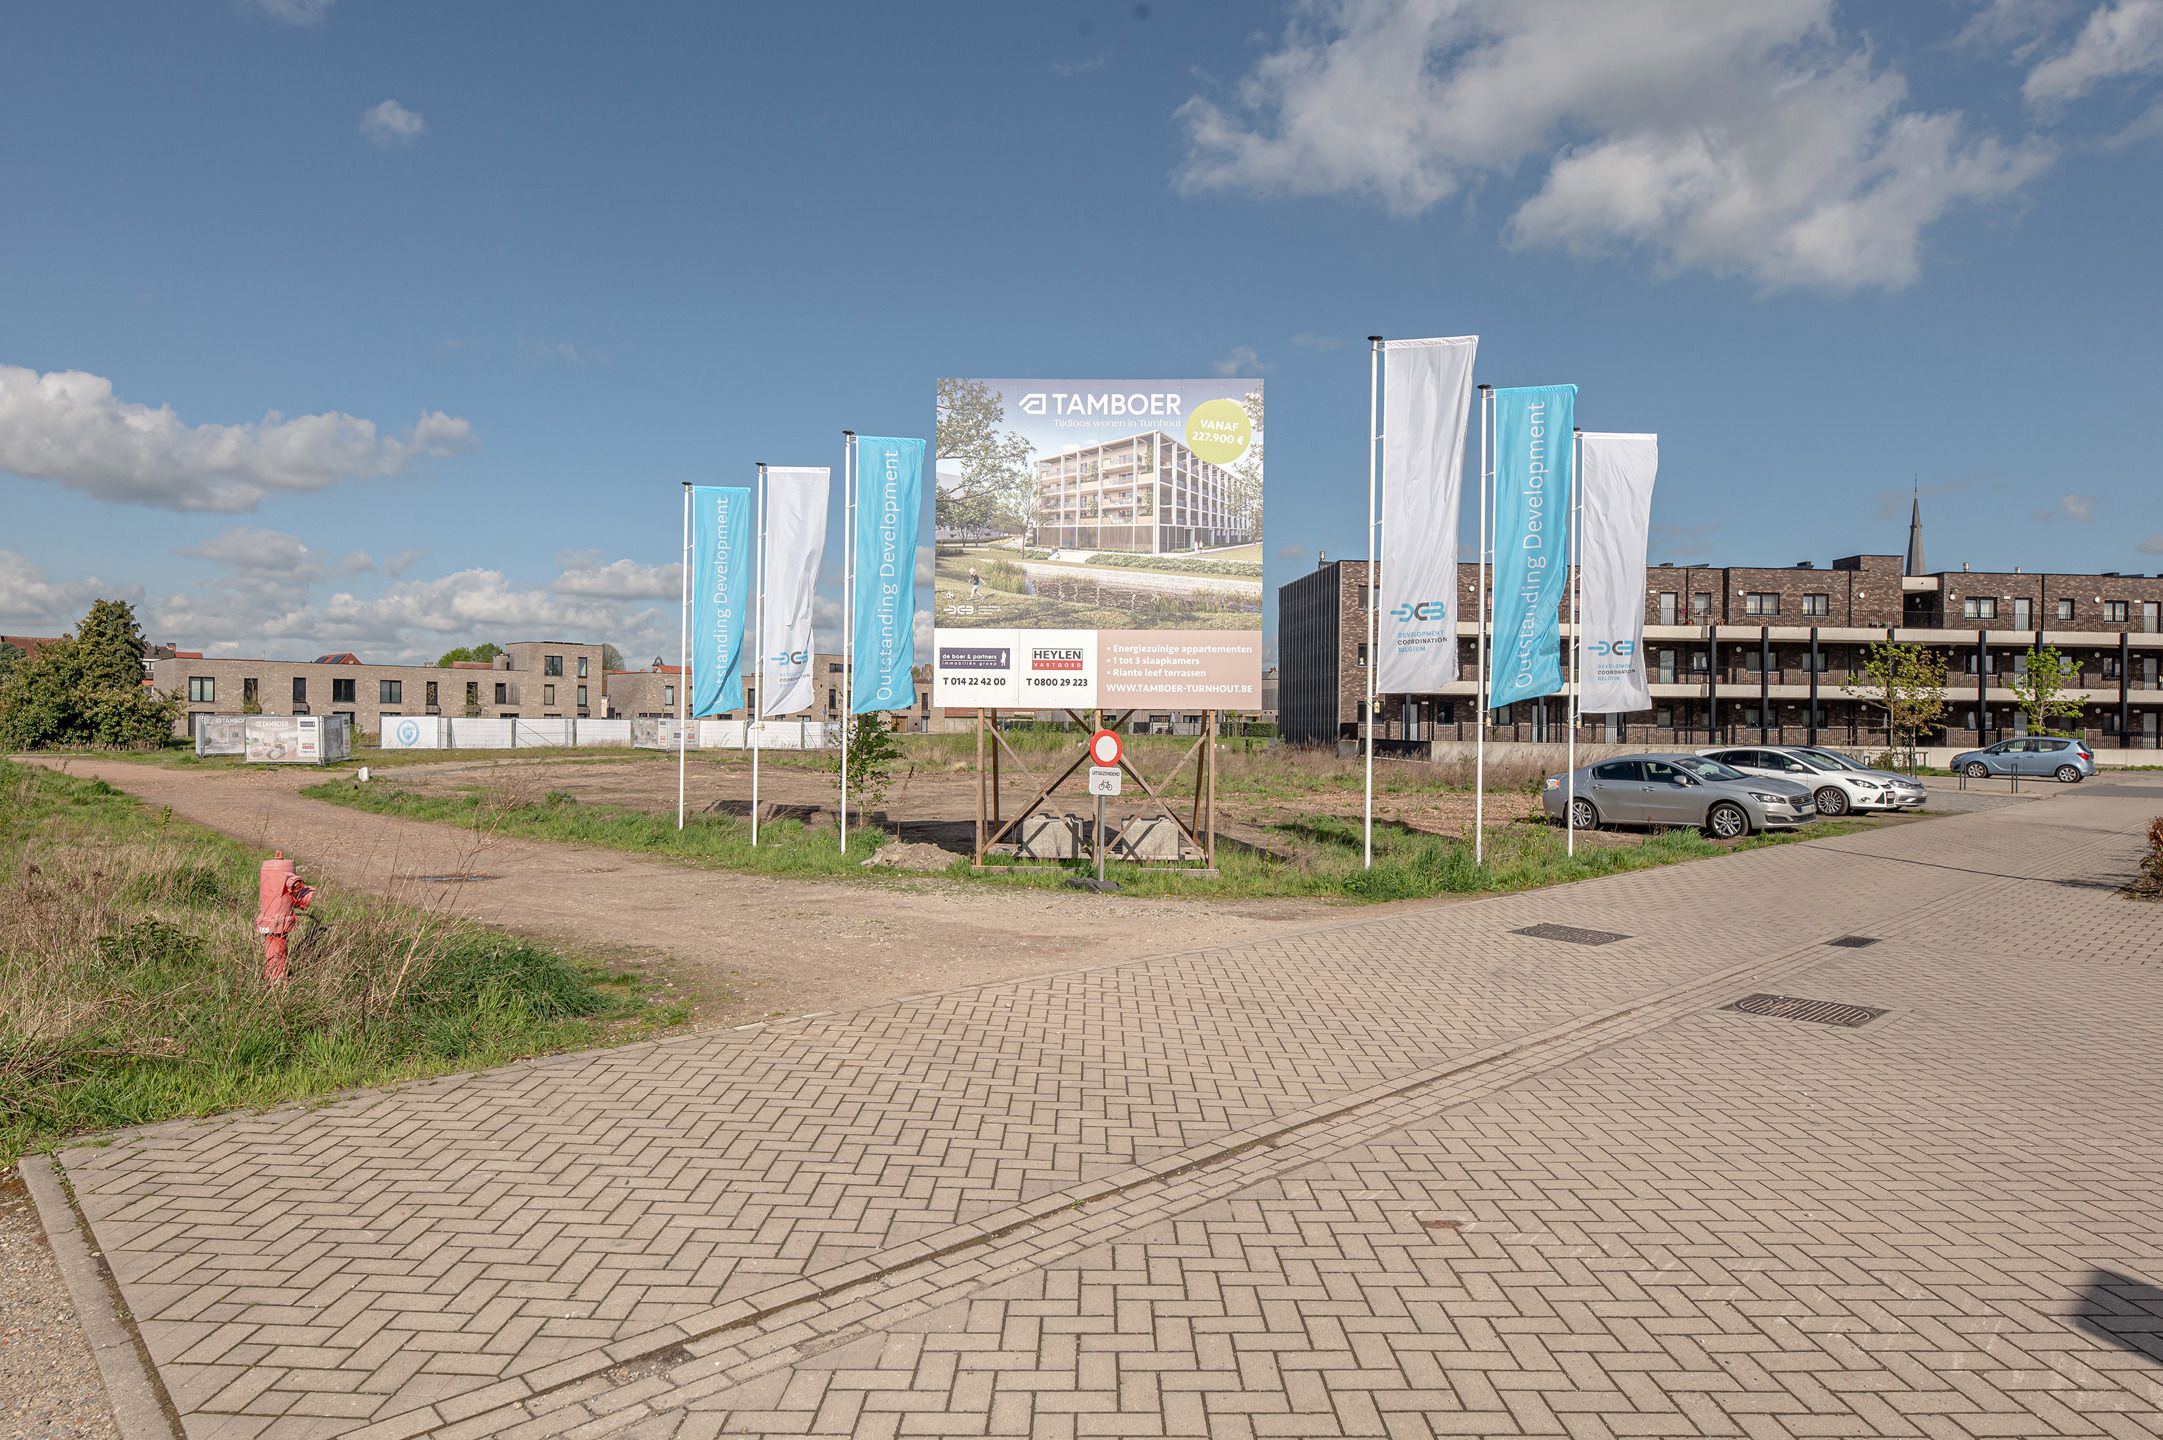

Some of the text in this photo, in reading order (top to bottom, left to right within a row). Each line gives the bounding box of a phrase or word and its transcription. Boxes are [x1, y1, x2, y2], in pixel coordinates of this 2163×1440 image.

[1052, 393, 1181, 415] TAMBOER
[1200, 418, 1240, 432] VANAF
[1191, 431, 1245, 446] 227.900 €
[1515, 401, 1549, 689] Outstanding Development
[713, 497, 731, 604] Development
[877, 449, 901, 701] Outstanding Development
[1397, 636, 1448, 646] COORDINATION
[1113, 644, 1253, 655] Energiezuinige appartementen
[972, 653, 997, 662] partners
[1034, 650, 1082, 660] HEYLEN
[1113, 656, 1200, 666] 1 tot 3 slaapkamers
[1113, 668, 1206, 677] Riante leef terrassen
[943, 677, 1006, 686] T 014 22 42 00
[1026, 678, 1088, 687] T 0800 29 223
[1106, 683, 1253, 693] WWW.TAMBOER-TURNHOUT.BE
